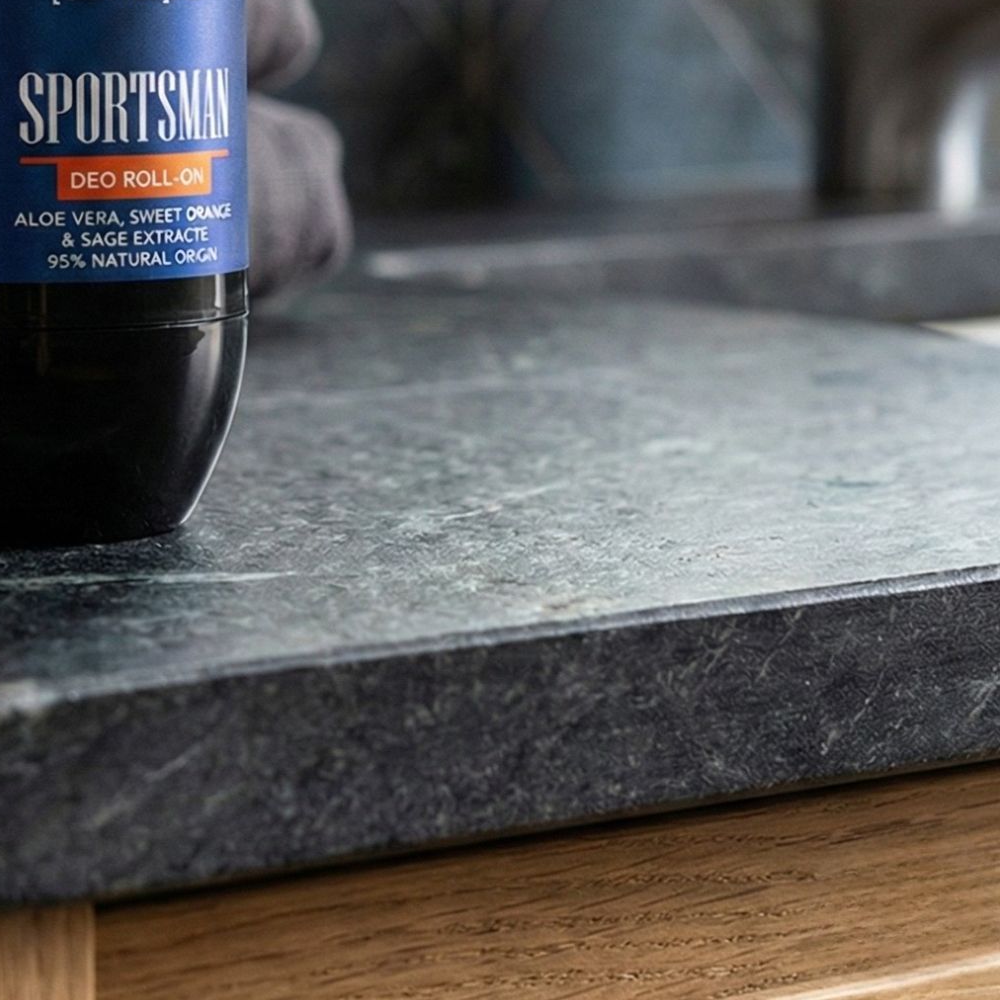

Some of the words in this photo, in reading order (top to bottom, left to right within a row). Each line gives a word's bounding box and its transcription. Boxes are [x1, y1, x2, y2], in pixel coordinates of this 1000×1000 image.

[19, 68, 229, 145] SPORTSMAN
[71, 171, 117, 189] DEO
[123, 168, 204, 188] ROLL-ON
[14, 211, 66, 227] ALOE
[72, 210, 125, 227] VERA,
[129, 207, 182, 225] SWEET
[61, 232, 75, 248] &
[81, 231, 128, 247] SAGE
[47, 254, 86, 269] 95%
[92, 251, 171, 268] NATURAL
